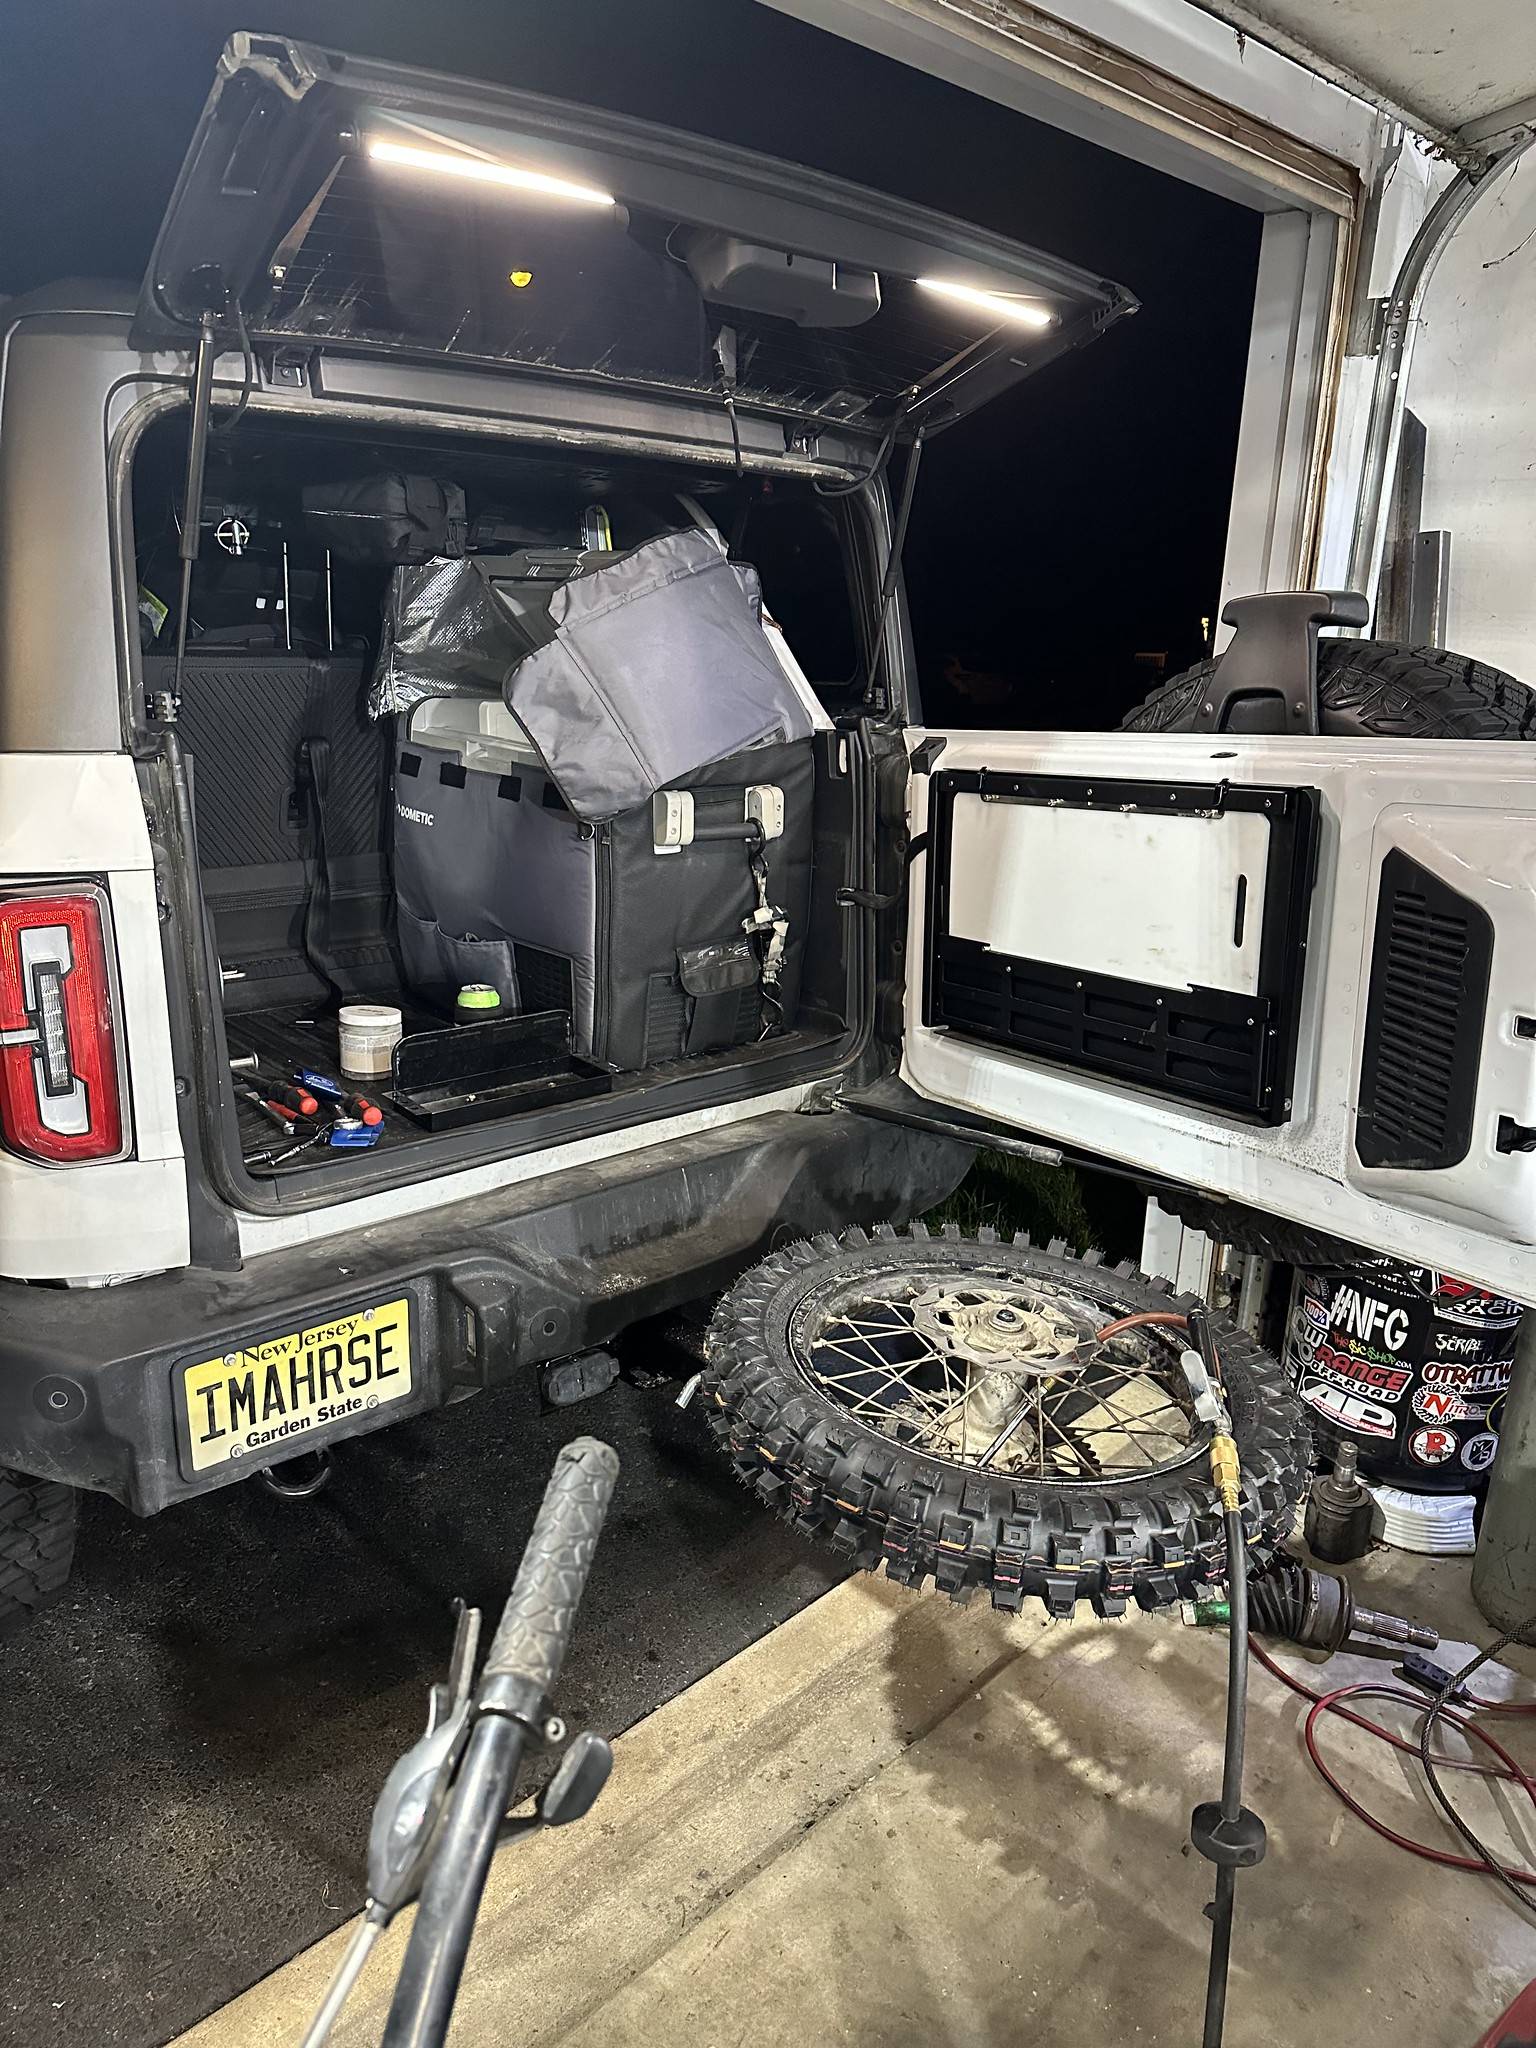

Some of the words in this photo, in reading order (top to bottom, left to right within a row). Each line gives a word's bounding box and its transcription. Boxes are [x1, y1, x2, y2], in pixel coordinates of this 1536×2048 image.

[401, 805, 434, 826] DOMETIC
[1306, 1302, 1326, 1325] 100%
[1330, 1284, 1409, 1351] #NFG
[241, 1340, 292, 1368] New
[295, 1319, 359, 1354] Jersey
[196, 1323, 400, 1444] IMAHRSE
[1314, 1345, 1408, 1393] RANGE
[246, 1417, 311, 1448] Garden
[317, 1396, 362, 1422] State
[1423, 1392, 1480, 1418] NITRO
